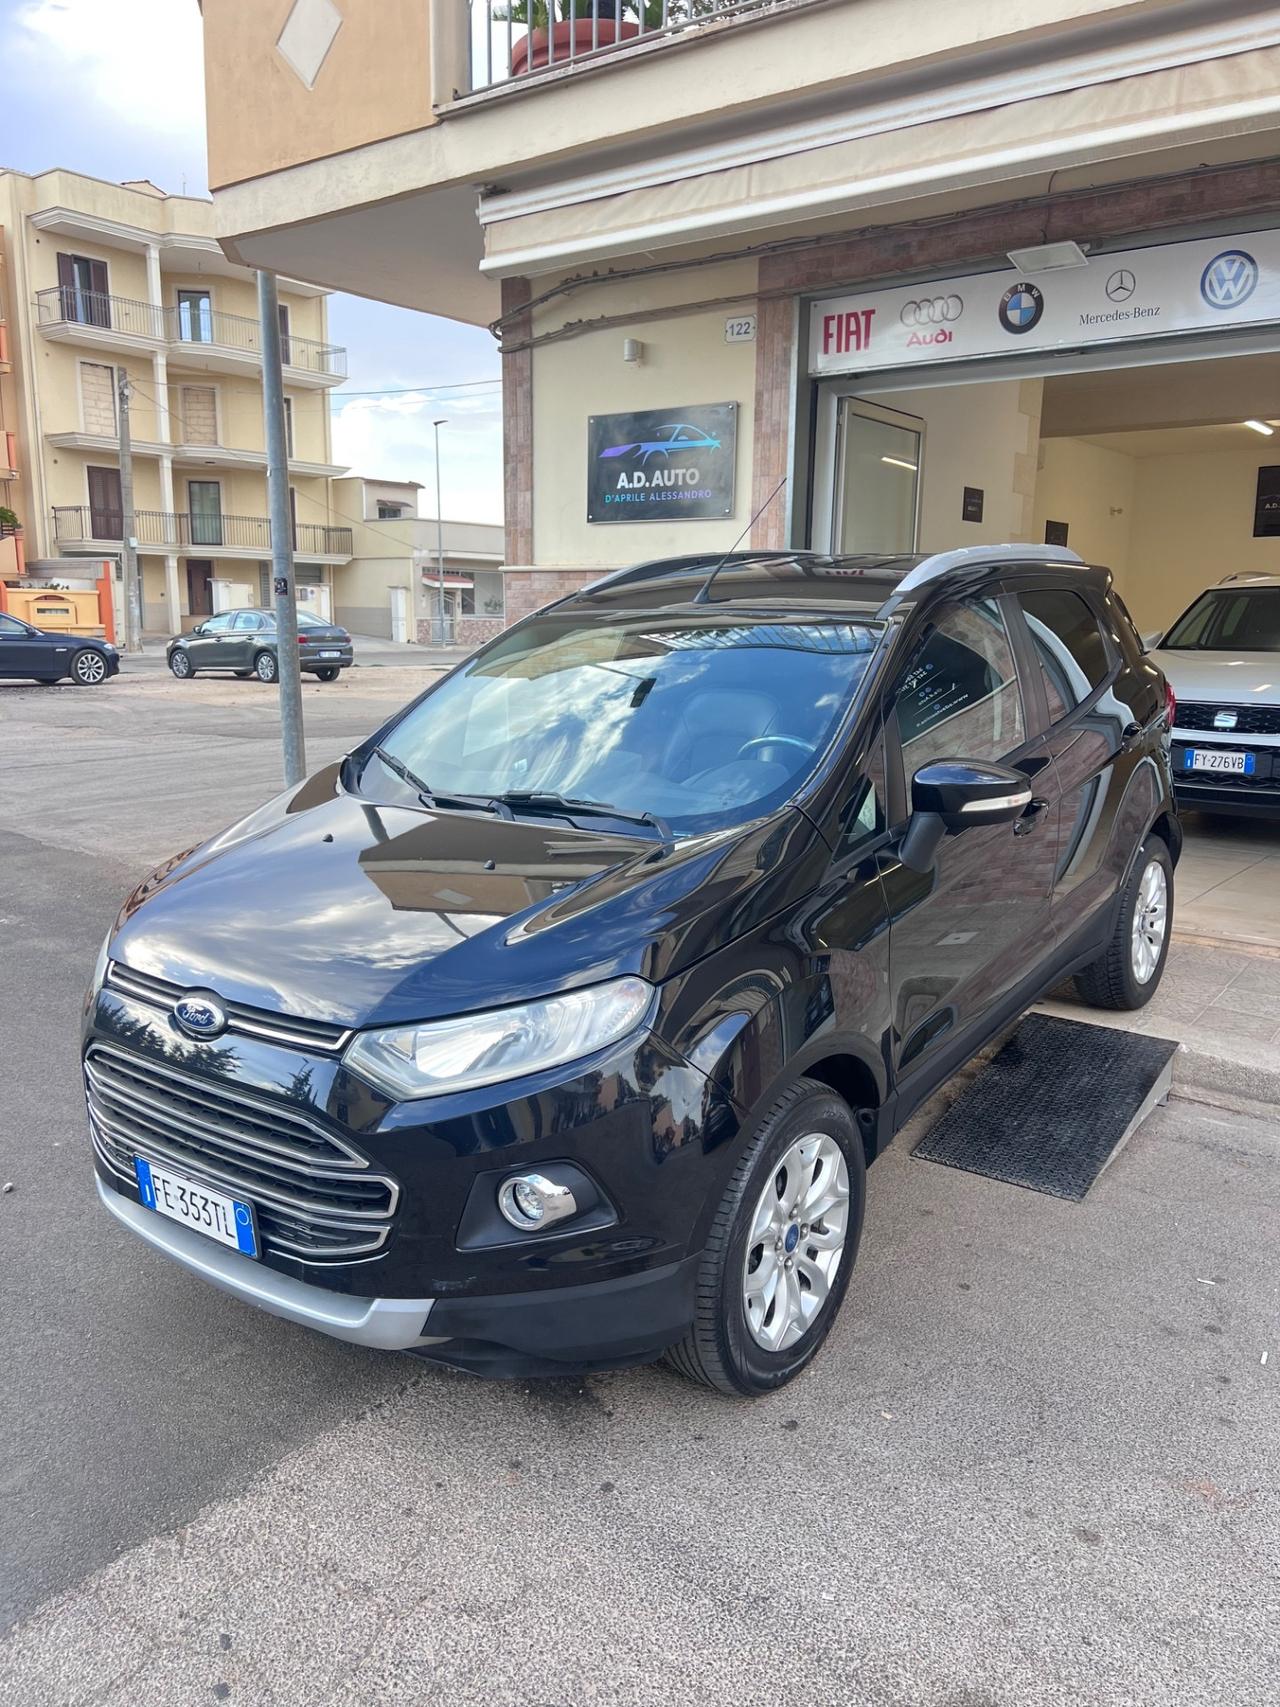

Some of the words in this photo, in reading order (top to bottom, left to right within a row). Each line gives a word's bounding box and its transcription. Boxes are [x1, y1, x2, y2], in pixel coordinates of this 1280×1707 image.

[1004, 283, 1041, 302] BMW
[1079, 305, 1161, 326] Mercedes-Benz
[729, 321, 751, 337] 122
[823, 309, 876, 354] FIAT
[906, 329, 953, 347] Audi
[617, 471, 650, 489] A.D.
[651, 468, 700, 487] AUTO
[605, 493, 646, 503] D'APRILE
[649, 489, 712, 501] ALESSANDRO
[1210, 755, 1244, 769] 276VB
[182, 1004, 210, 1025] Ford
[152, 1173, 175, 1210] FE
[177, 1185, 236, 1239] 353TL
